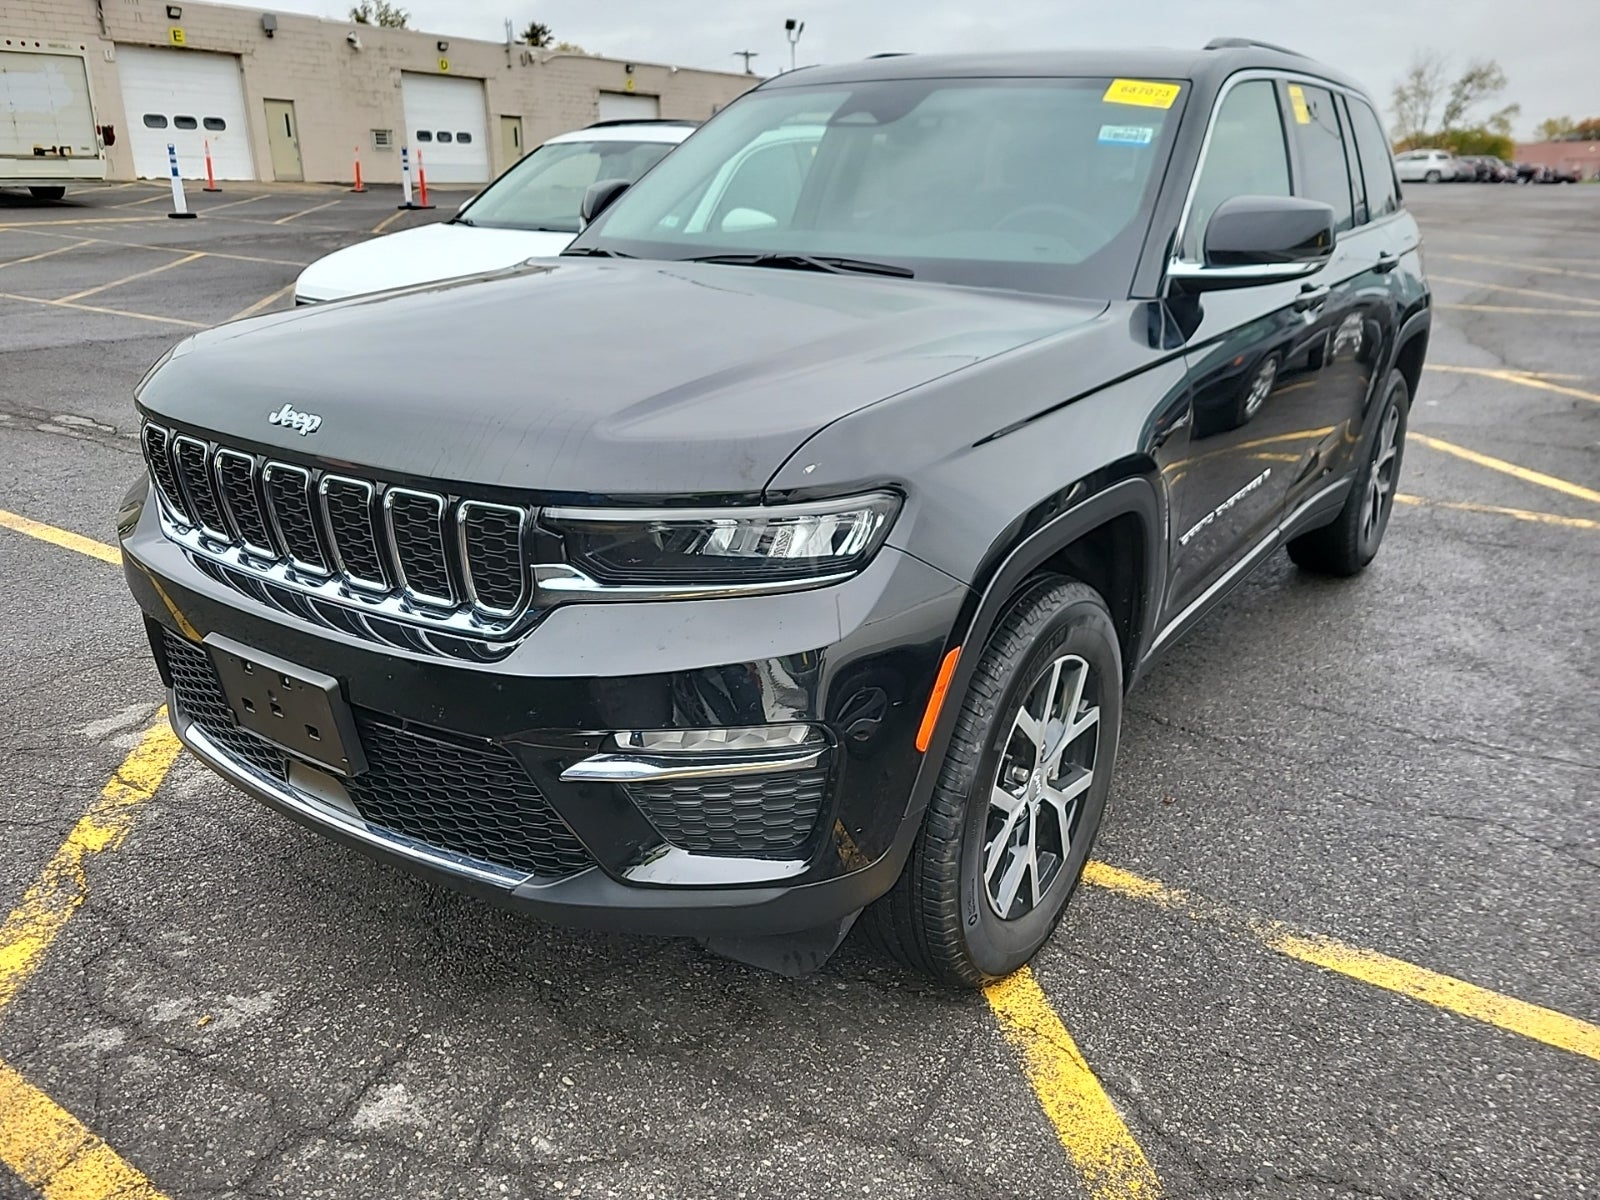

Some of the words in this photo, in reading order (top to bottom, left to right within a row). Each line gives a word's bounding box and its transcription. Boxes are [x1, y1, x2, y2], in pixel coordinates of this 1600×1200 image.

[172, 29, 183, 42] E
[440, 59, 448, 71] D
[268, 403, 322, 436] Jeep
